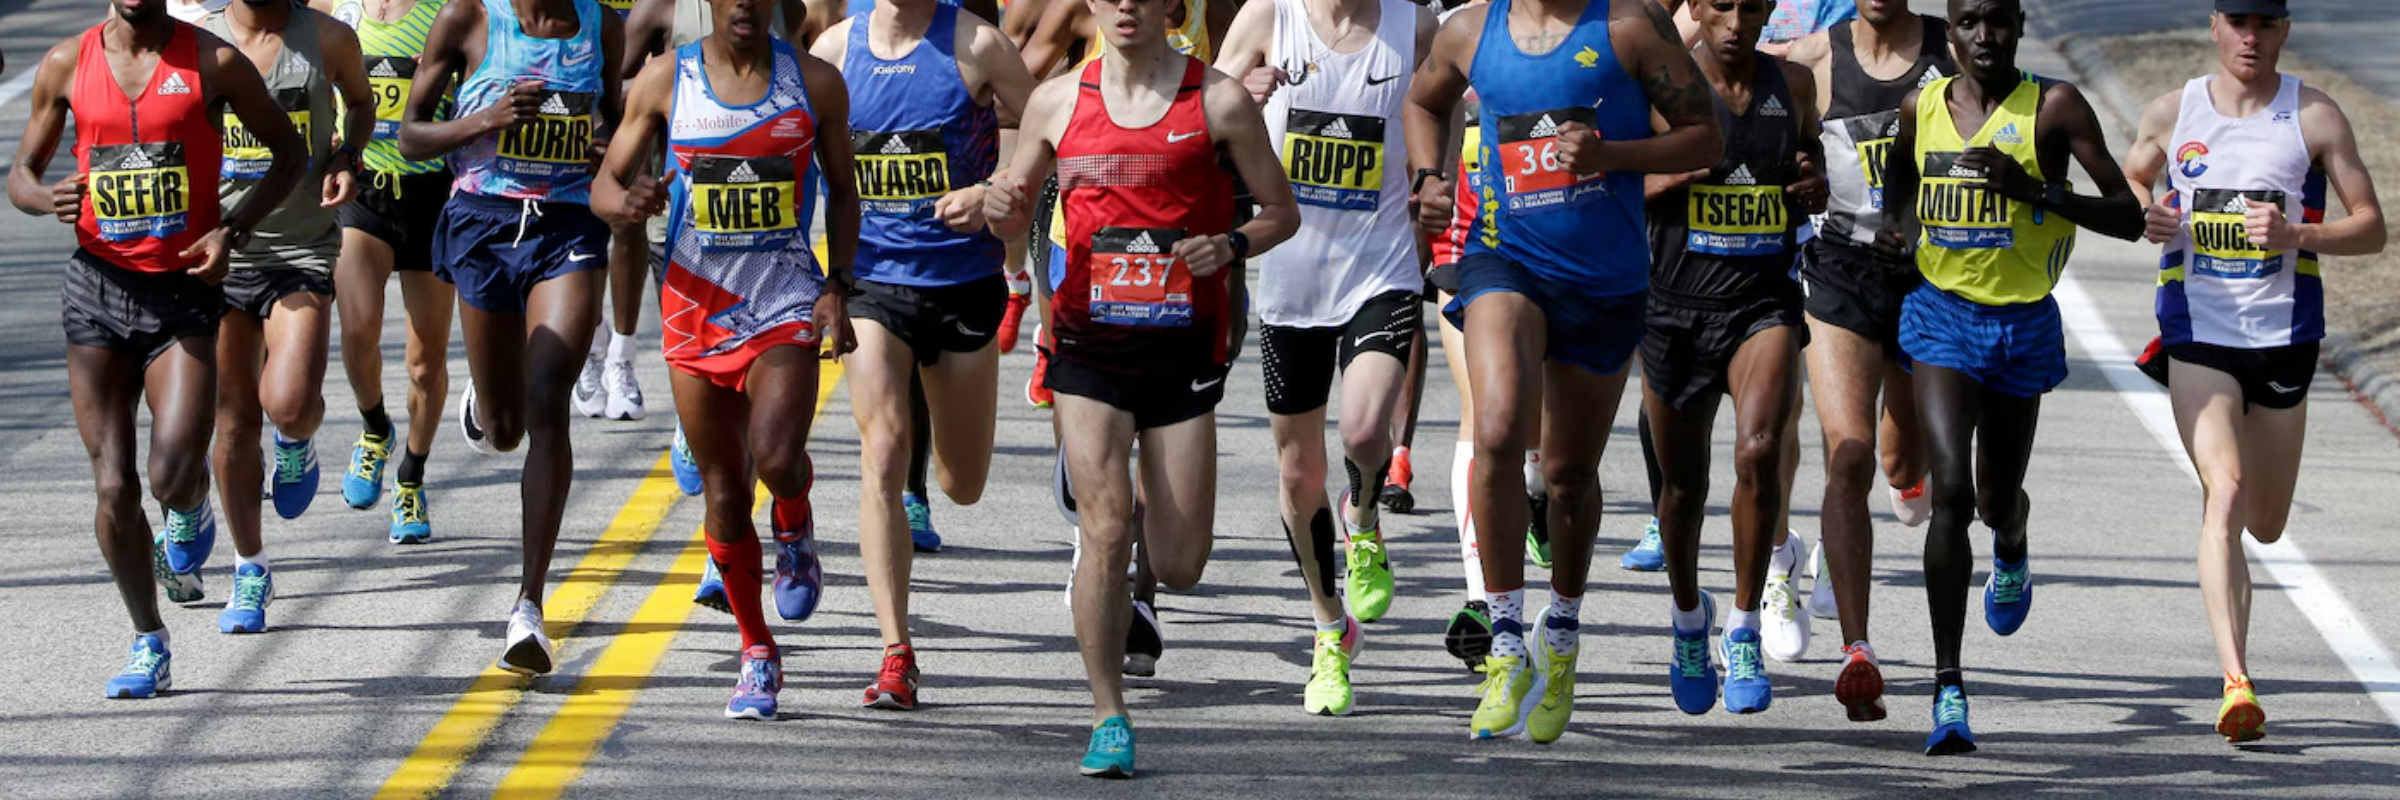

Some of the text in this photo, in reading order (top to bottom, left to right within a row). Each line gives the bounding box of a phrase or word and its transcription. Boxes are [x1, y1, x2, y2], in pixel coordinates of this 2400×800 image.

[873, 64, 916, 75] saucony
[1760, 108, 1788, 117] adidas
[502, 118, 590, 160] KORIR
[1320, 128, 1353, 139] adidas
[1529, 129, 1558, 138] adida
[1290, 138, 1376, 186] RUPP
[1518, 141, 1559, 175] 36
[1948, 166, 1979, 177] adidas
[727, 174, 760, 182] adidas
[854, 157, 946, 196] WARD
[1724, 177, 1757, 185] adidas
[96, 171, 183, 217] SEFIR
[708, 187, 781, 230] MEB
[1692, 192, 1781, 226] TSEGAY
[1921, 183, 2008, 223] MUTAI
[1126, 244, 1160, 253] adidas
[2195, 221, 2269, 252] QUIG
[1111, 257, 1175, 287] 237
